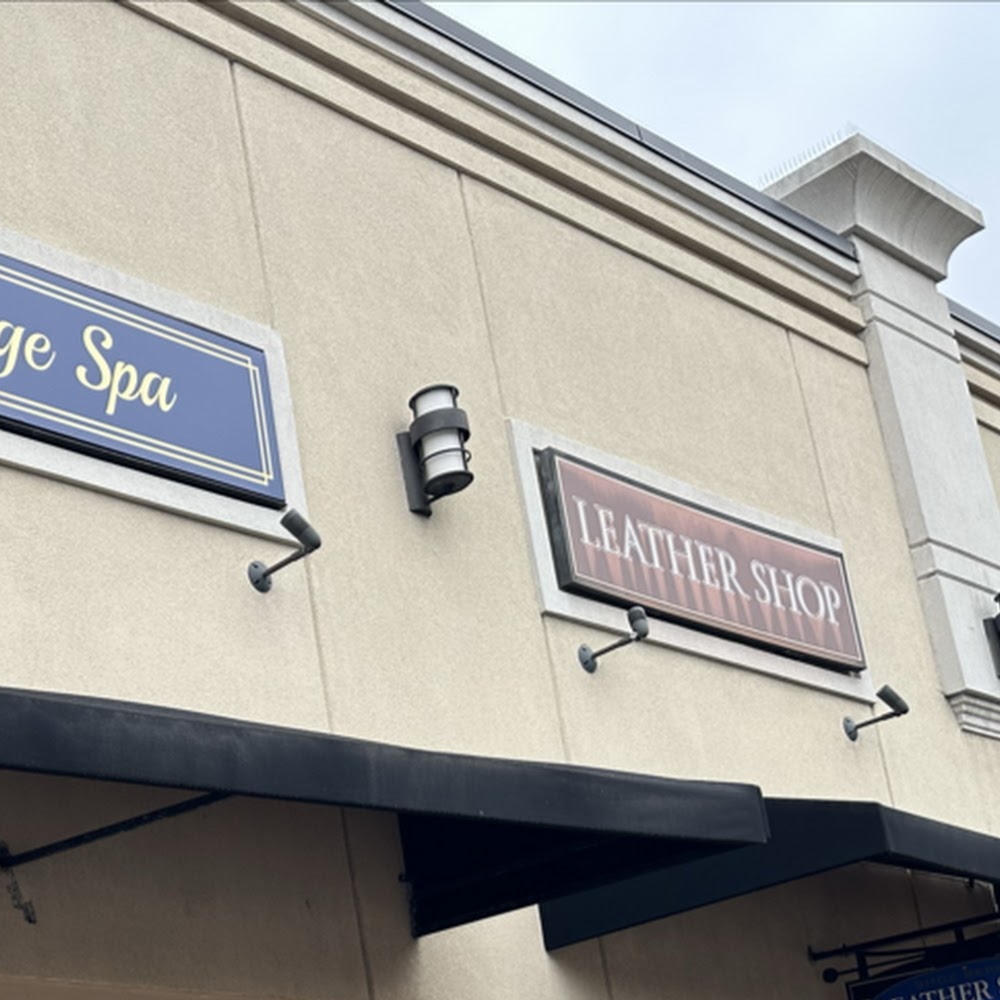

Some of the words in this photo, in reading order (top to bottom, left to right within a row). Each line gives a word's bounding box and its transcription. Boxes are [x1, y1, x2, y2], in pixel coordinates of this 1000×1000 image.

[75, 325, 178, 415] Spa
[572, 495, 750, 600] LEATHER
[751, 559, 842, 626] SHOP
